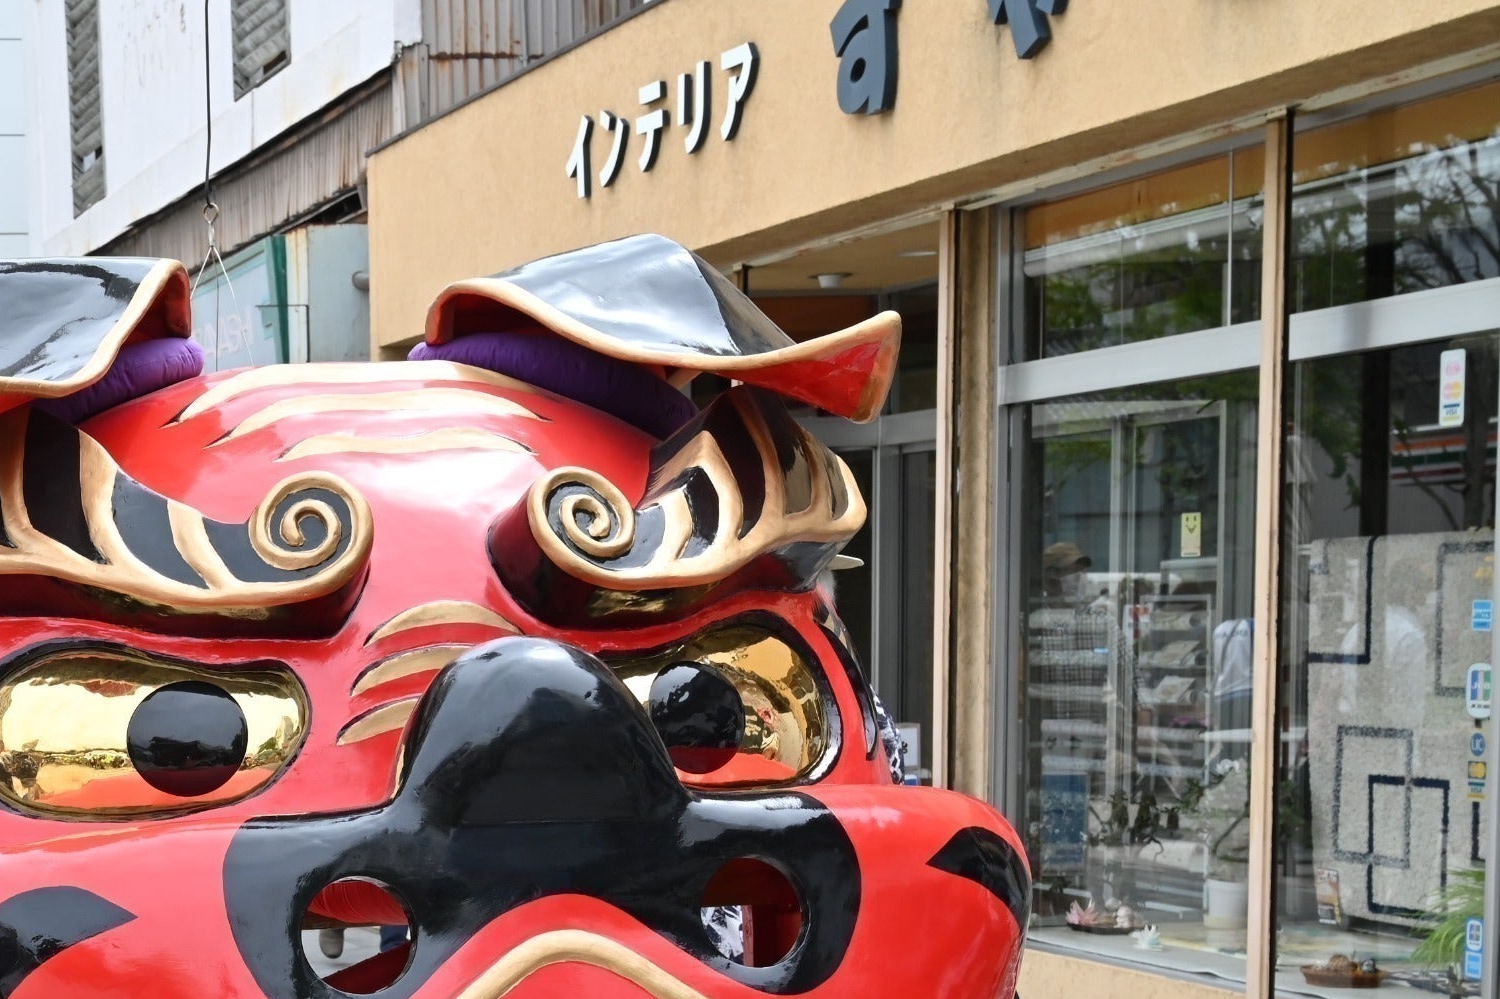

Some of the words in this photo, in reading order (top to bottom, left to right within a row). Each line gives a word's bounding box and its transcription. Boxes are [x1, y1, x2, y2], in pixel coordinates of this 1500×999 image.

[565, 42, 759, 199] インテリア
